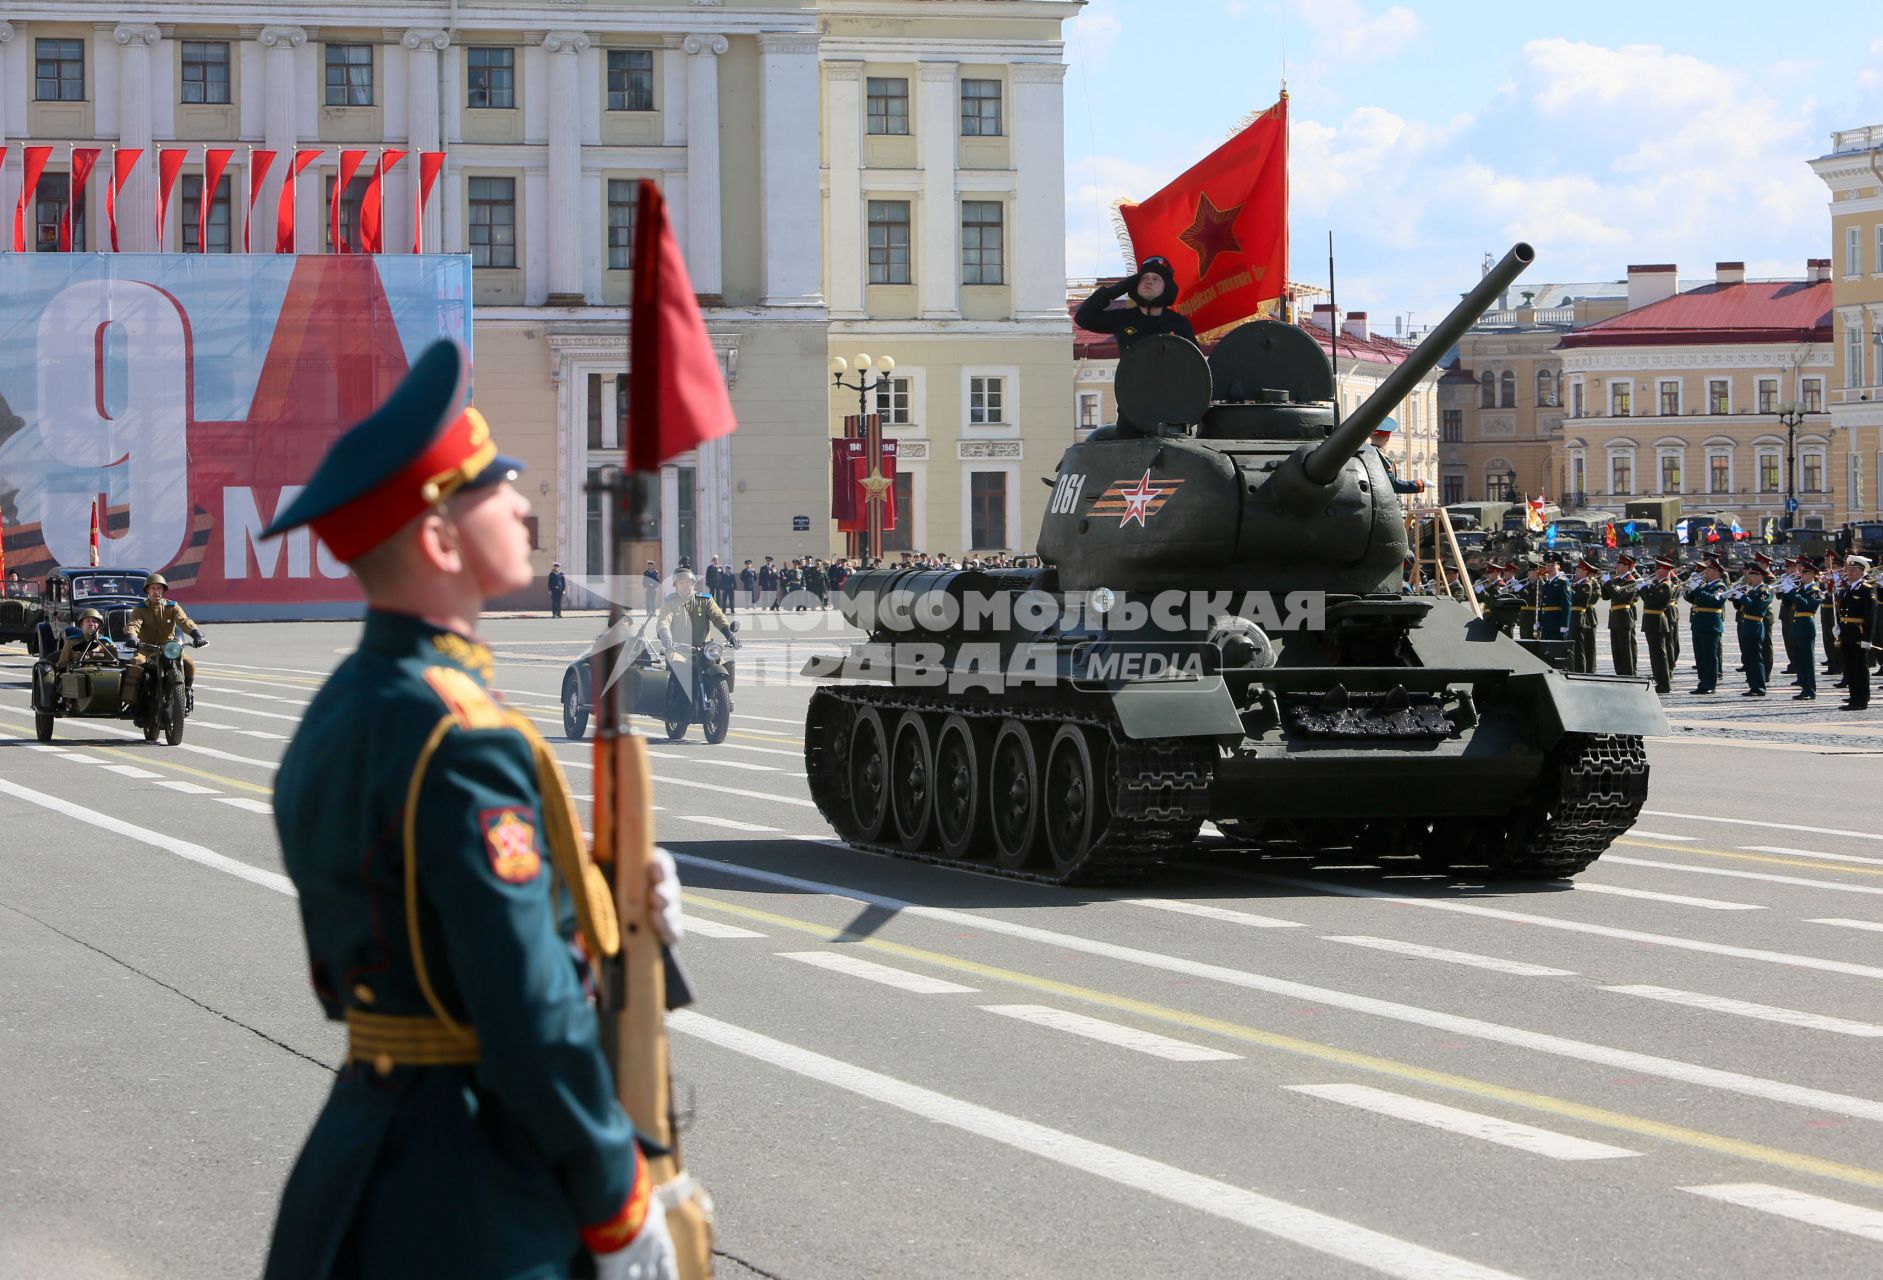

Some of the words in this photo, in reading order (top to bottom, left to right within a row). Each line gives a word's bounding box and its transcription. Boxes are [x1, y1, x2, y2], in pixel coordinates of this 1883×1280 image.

[36, 279, 190, 570] 9
[849, 442, 862, 452] 1941
[882, 443, 896, 452] 1945
[1051, 474, 1087, 514] 061
